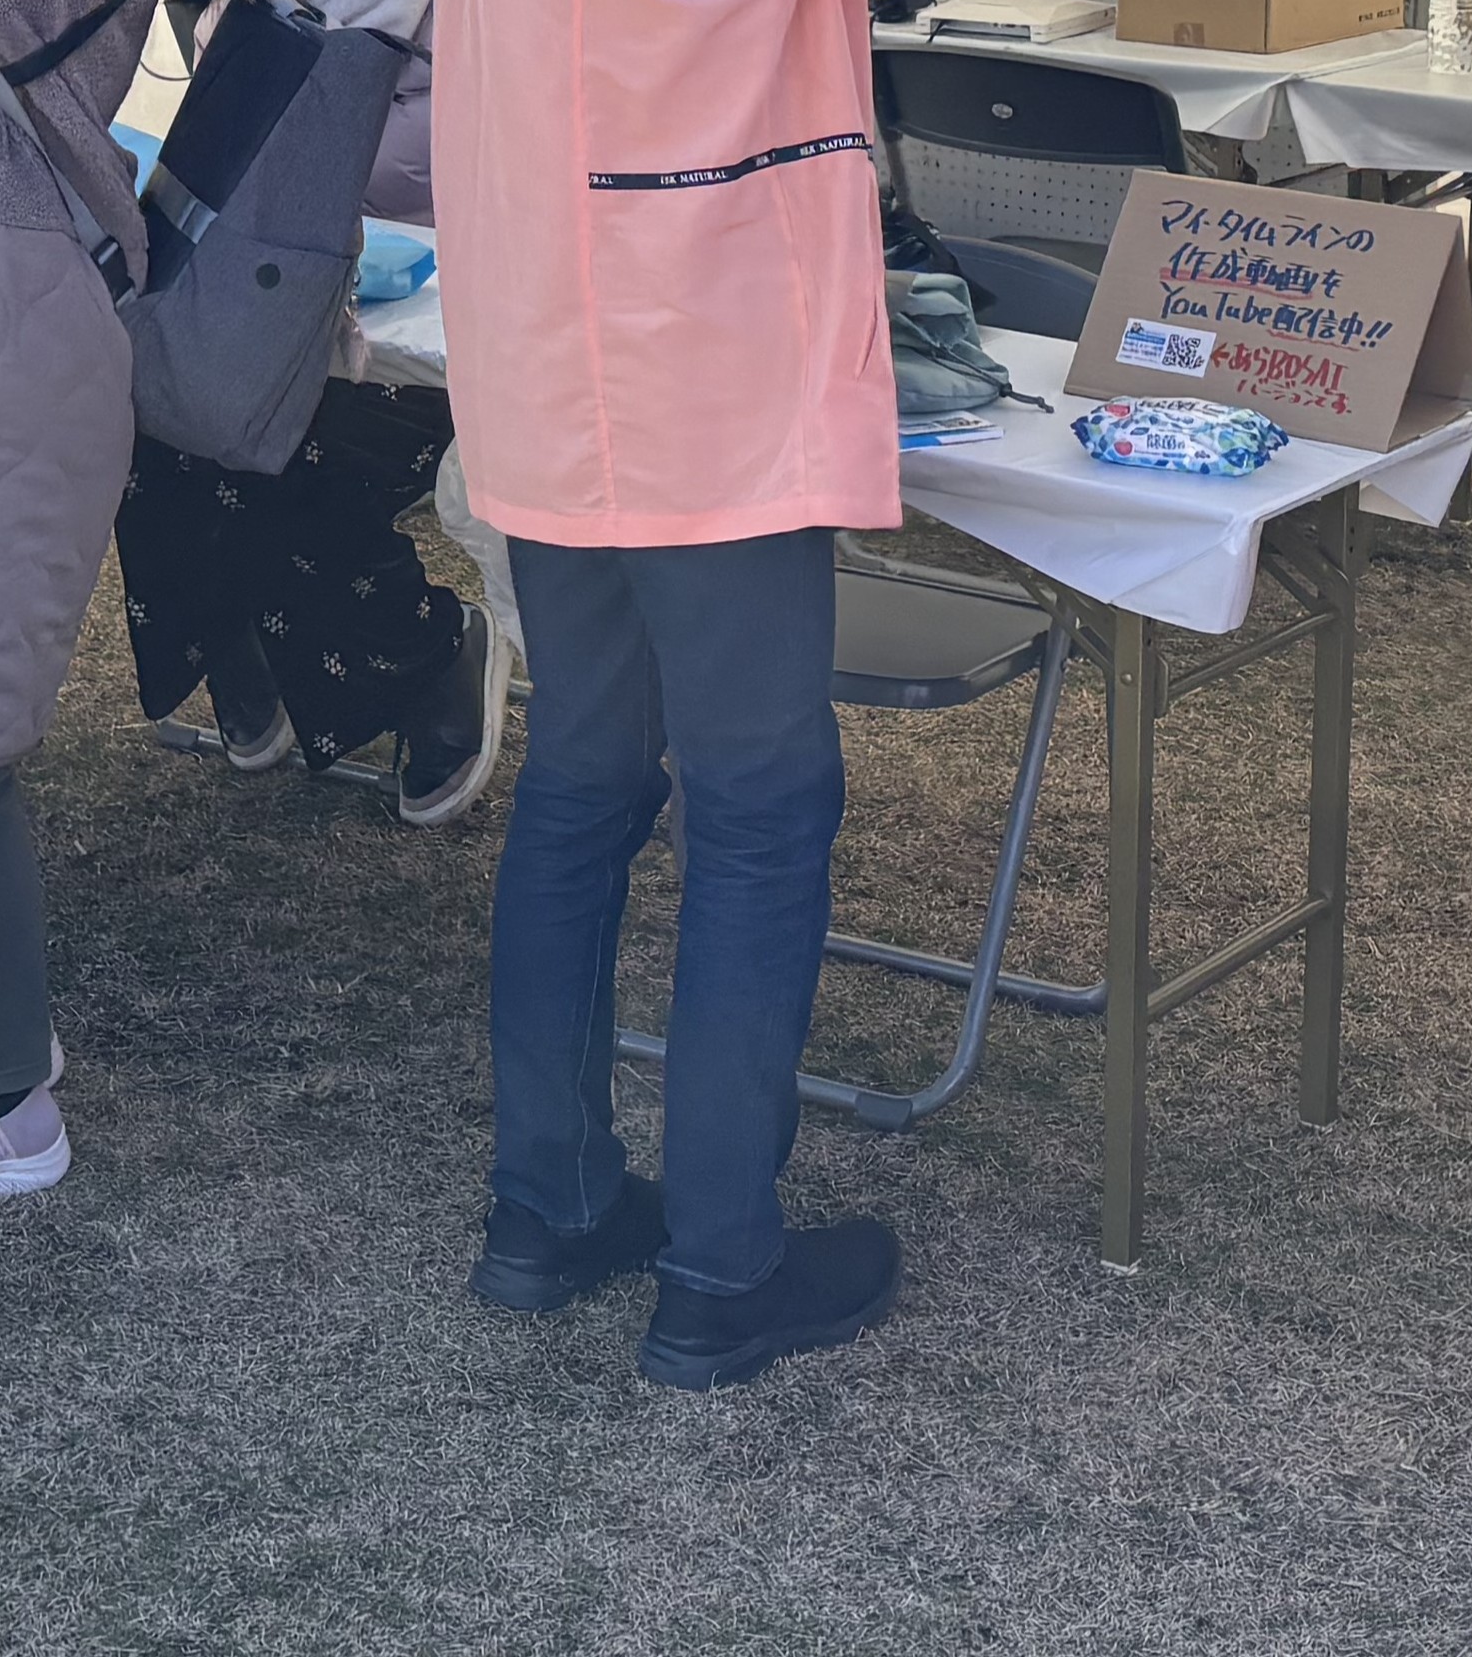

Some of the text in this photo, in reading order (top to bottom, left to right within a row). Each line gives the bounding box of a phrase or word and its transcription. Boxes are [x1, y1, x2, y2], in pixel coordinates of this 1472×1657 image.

[679, 170, 728, 184] NATURAL
[1169, 242, 1345, 298] 作成動画を
